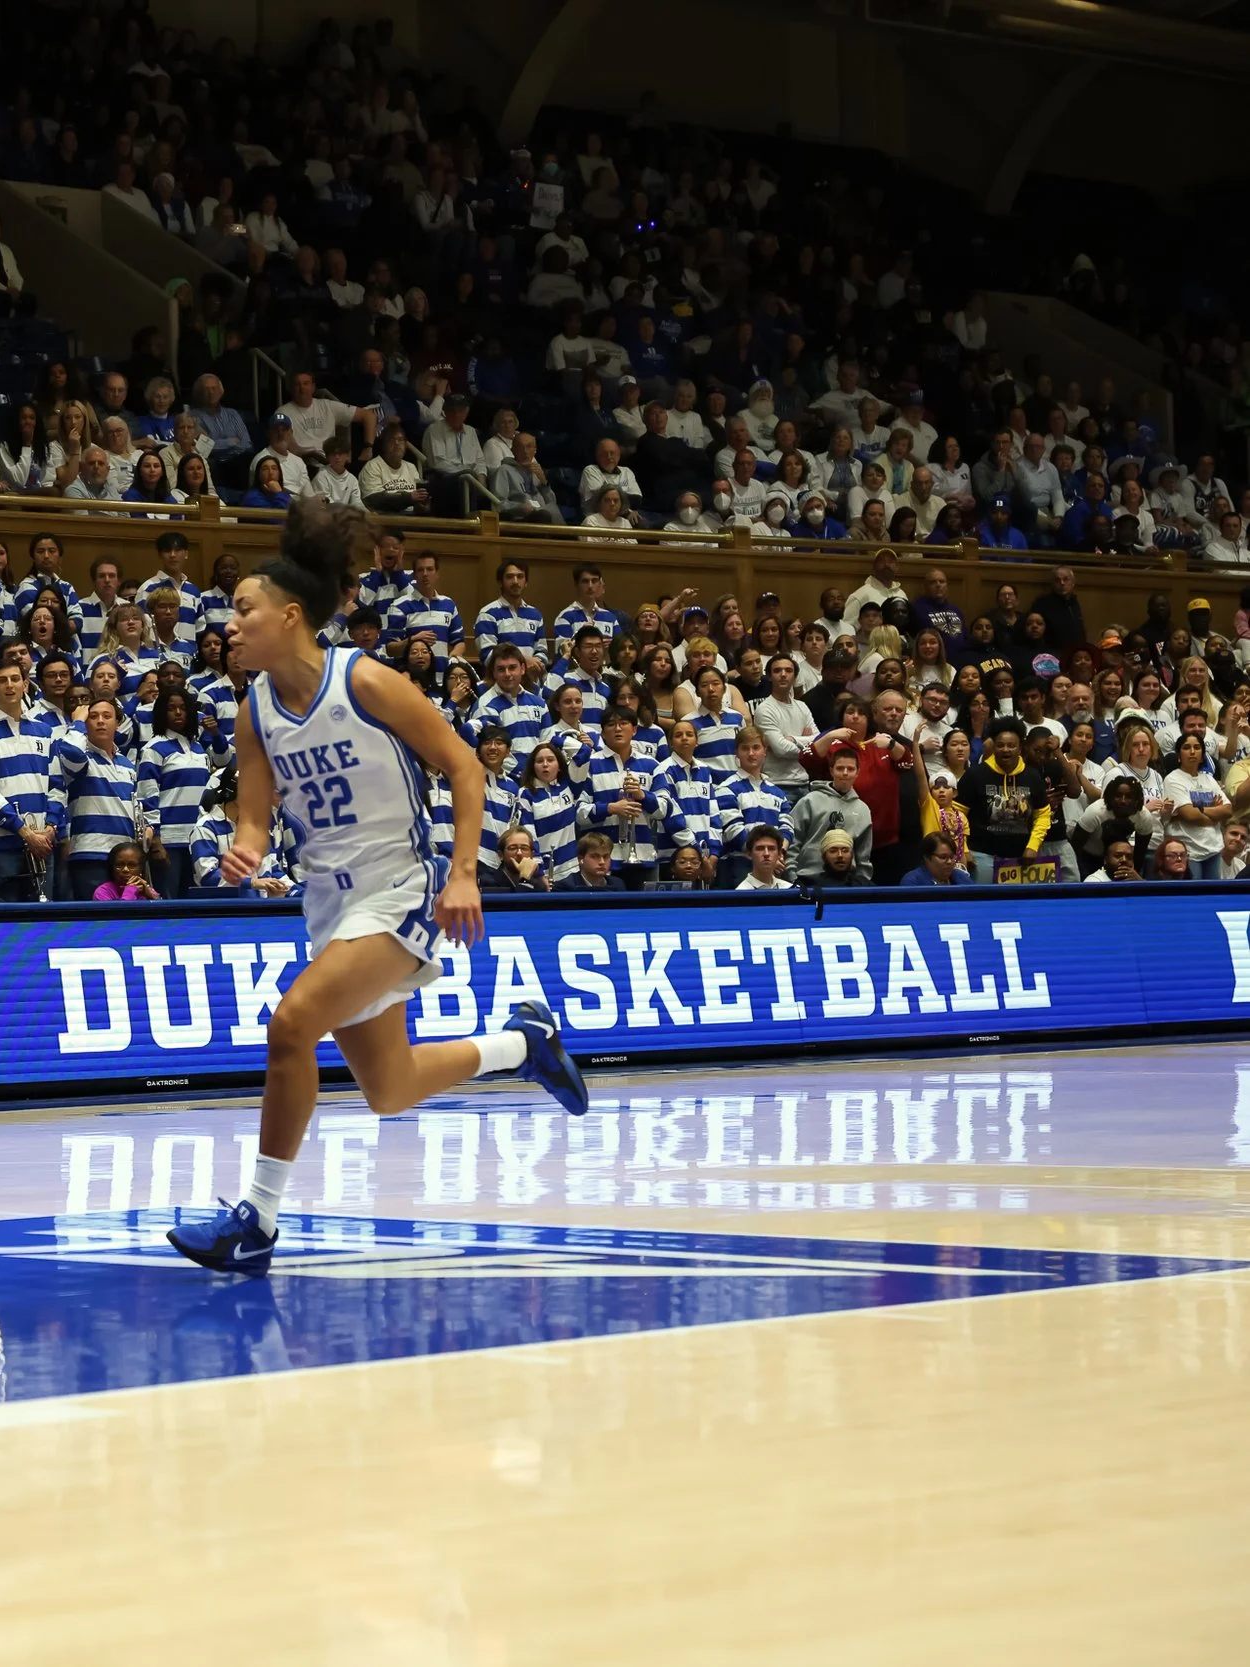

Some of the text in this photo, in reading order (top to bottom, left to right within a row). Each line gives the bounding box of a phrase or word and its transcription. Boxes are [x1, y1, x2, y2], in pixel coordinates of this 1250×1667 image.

[274, 740, 360, 781] DUKE
[300, 775, 358, 828] 22
[1000, 869, 1017, 882] BIG
[48, 921, 1051, 1054] DUK BASKETBALL
[146, 1079, 189, 1087] DAKTRONICS
